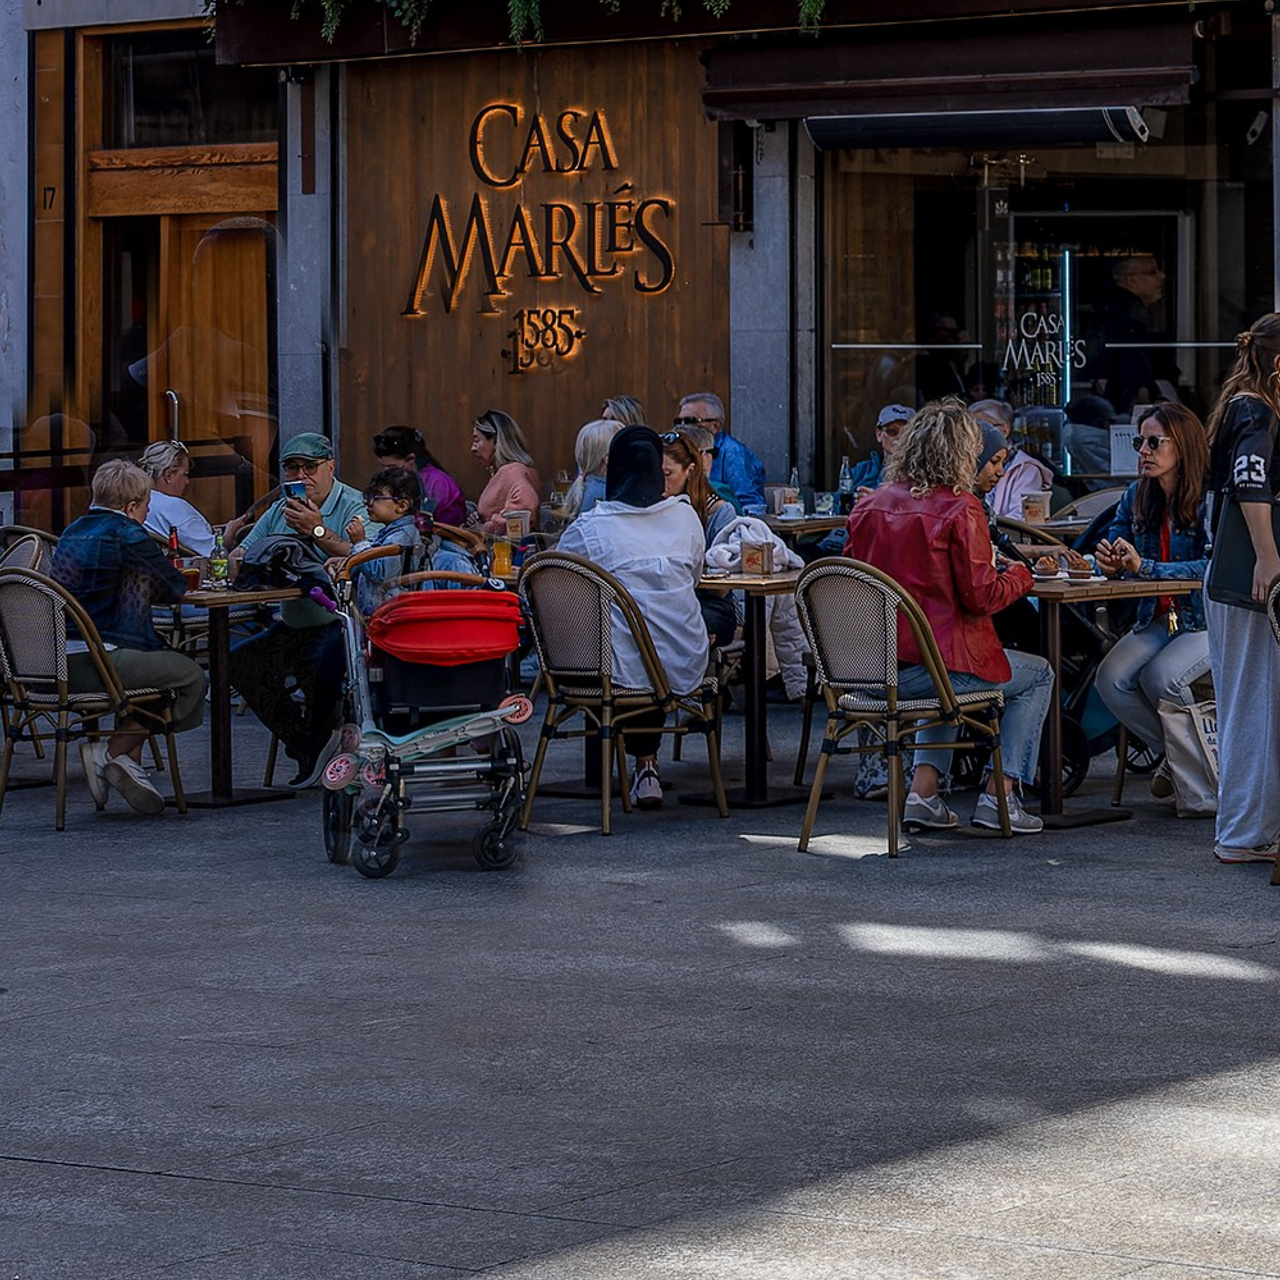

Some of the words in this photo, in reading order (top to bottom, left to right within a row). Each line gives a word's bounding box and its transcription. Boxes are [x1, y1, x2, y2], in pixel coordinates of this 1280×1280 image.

[469, 103, 619, 188] CASA
[43, 186, 56, 210] 17
[400, 182, 676, 316] MARLÉS
[1021, 312, 1065, 338] CASA
[1233, 453, 1266, 485] 23
